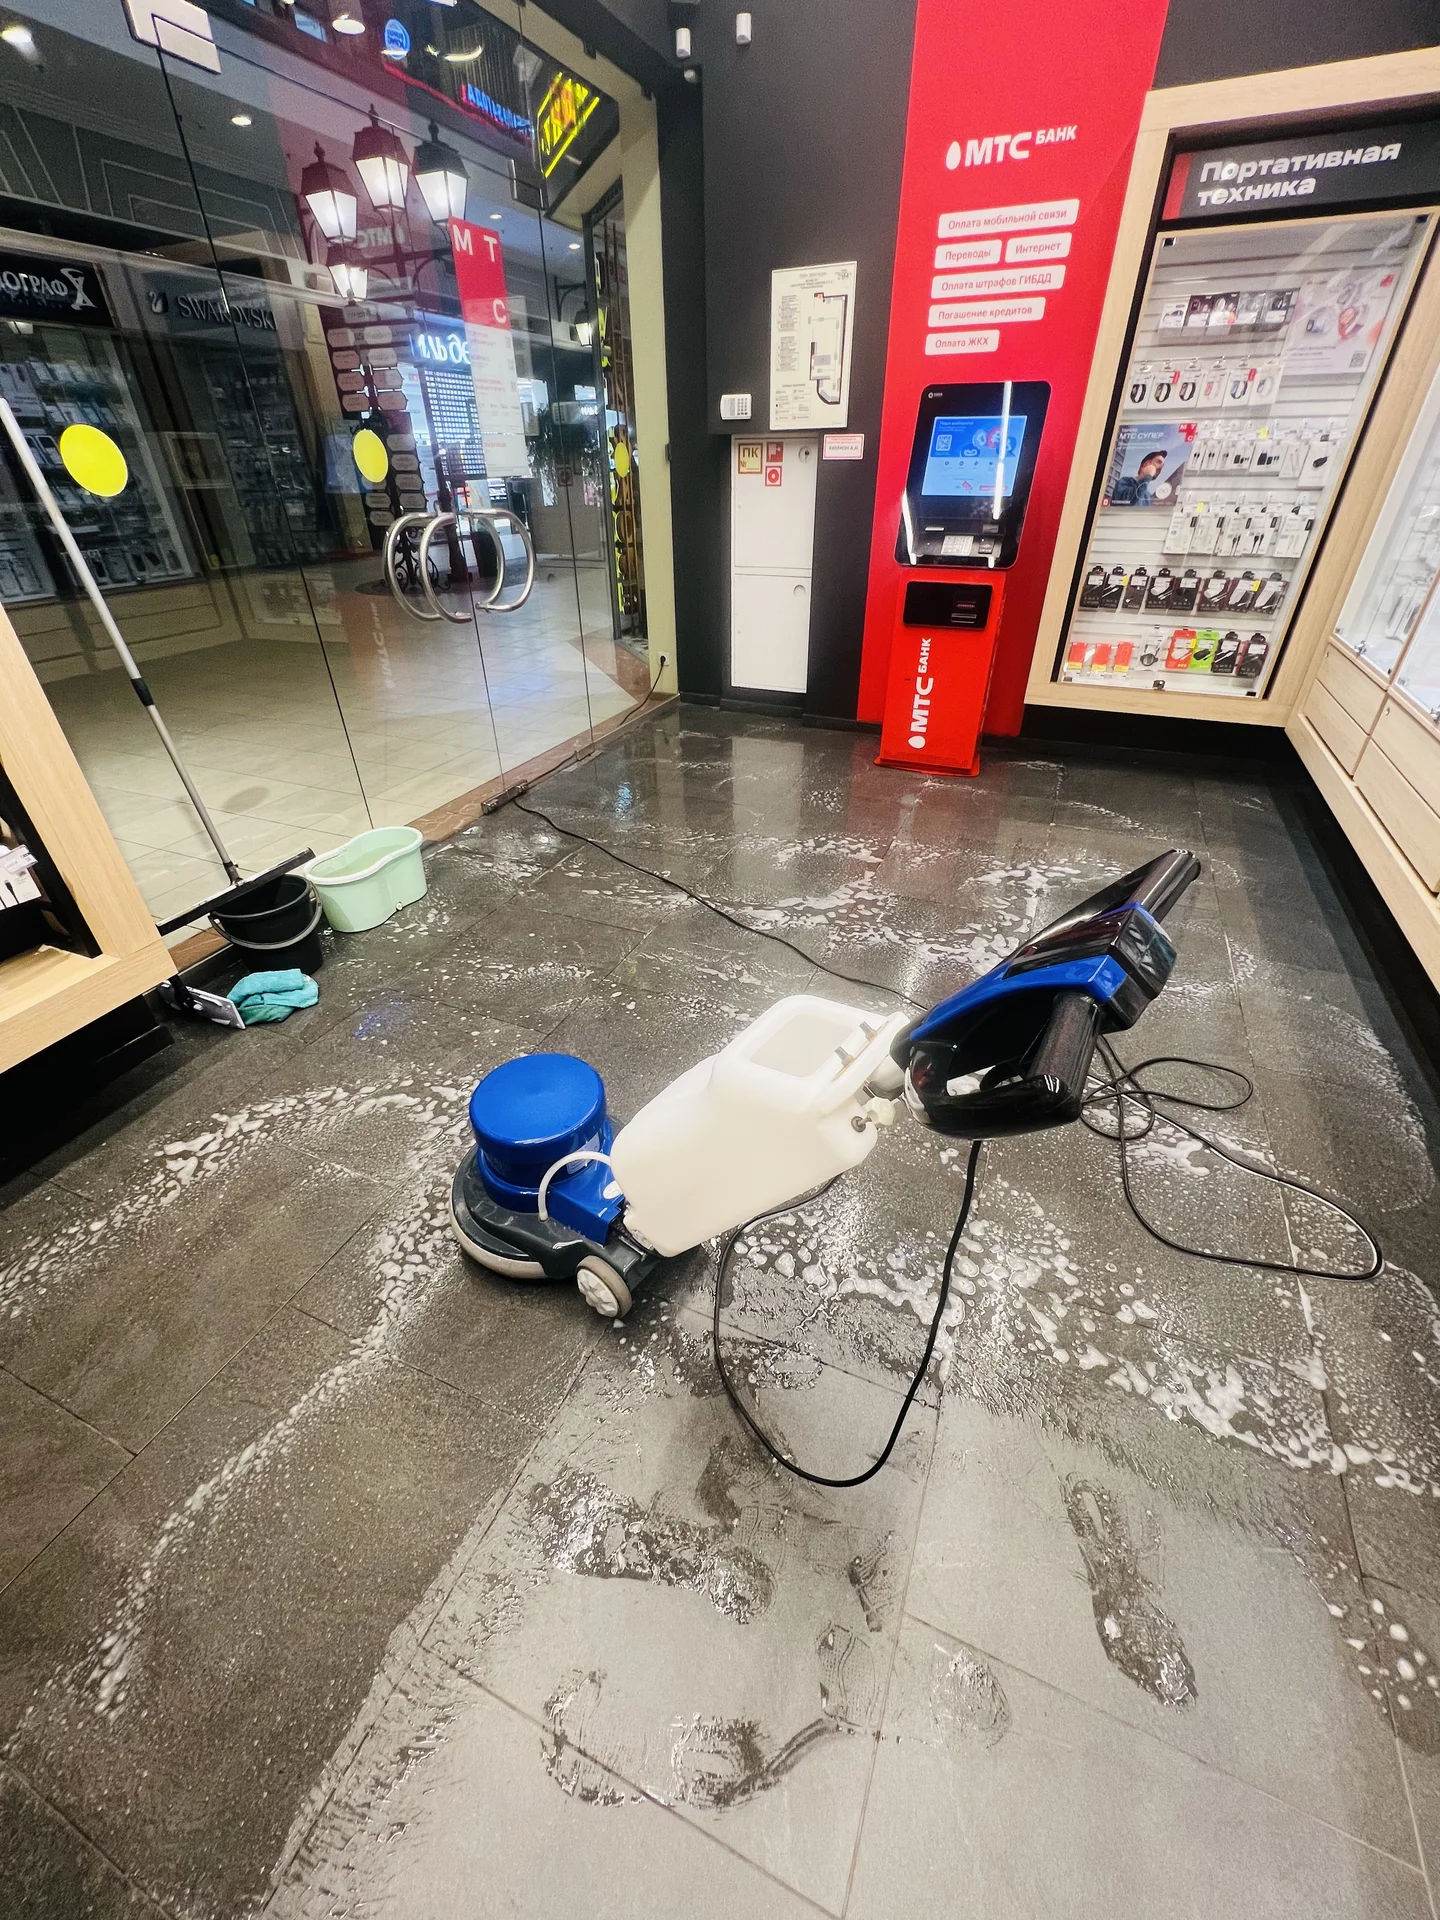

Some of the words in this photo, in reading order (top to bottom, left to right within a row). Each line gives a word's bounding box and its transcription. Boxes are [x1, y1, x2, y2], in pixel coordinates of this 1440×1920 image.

[964, 131, 1033, 167] МТС
[1035, 125, 1078, 145] БАНК
[1199, 142, 1402, 184] Портативная
[1197, 177, 1317, 207] техника
[948, 218, 982, 230] Оплата
[983, 210, 1036, 229] мобильной
[1038, 210, 1067, 222] связи
[945, 248, 991, 263] Переводы
[1015, 241, 1061, 254] Интернет
[0, 270, 68, 297] ОГРАФ
[941, 280, 974, 292] Оплата
[975, 277, 1017, 292] штрафов
[1019, 272, 1052, 286] ГИБДД
[938, 310, 988, 321] Погашение
[989, 305, 1032, 319] кредитов
[935, 338, 966, 348] Оплата
[967, 337, 989, 347] ЖКХ
[742, 447, 759, 458] ПК
[918, 637, 932, 674] БАНК
[910, 676, 934, 733] МТС
